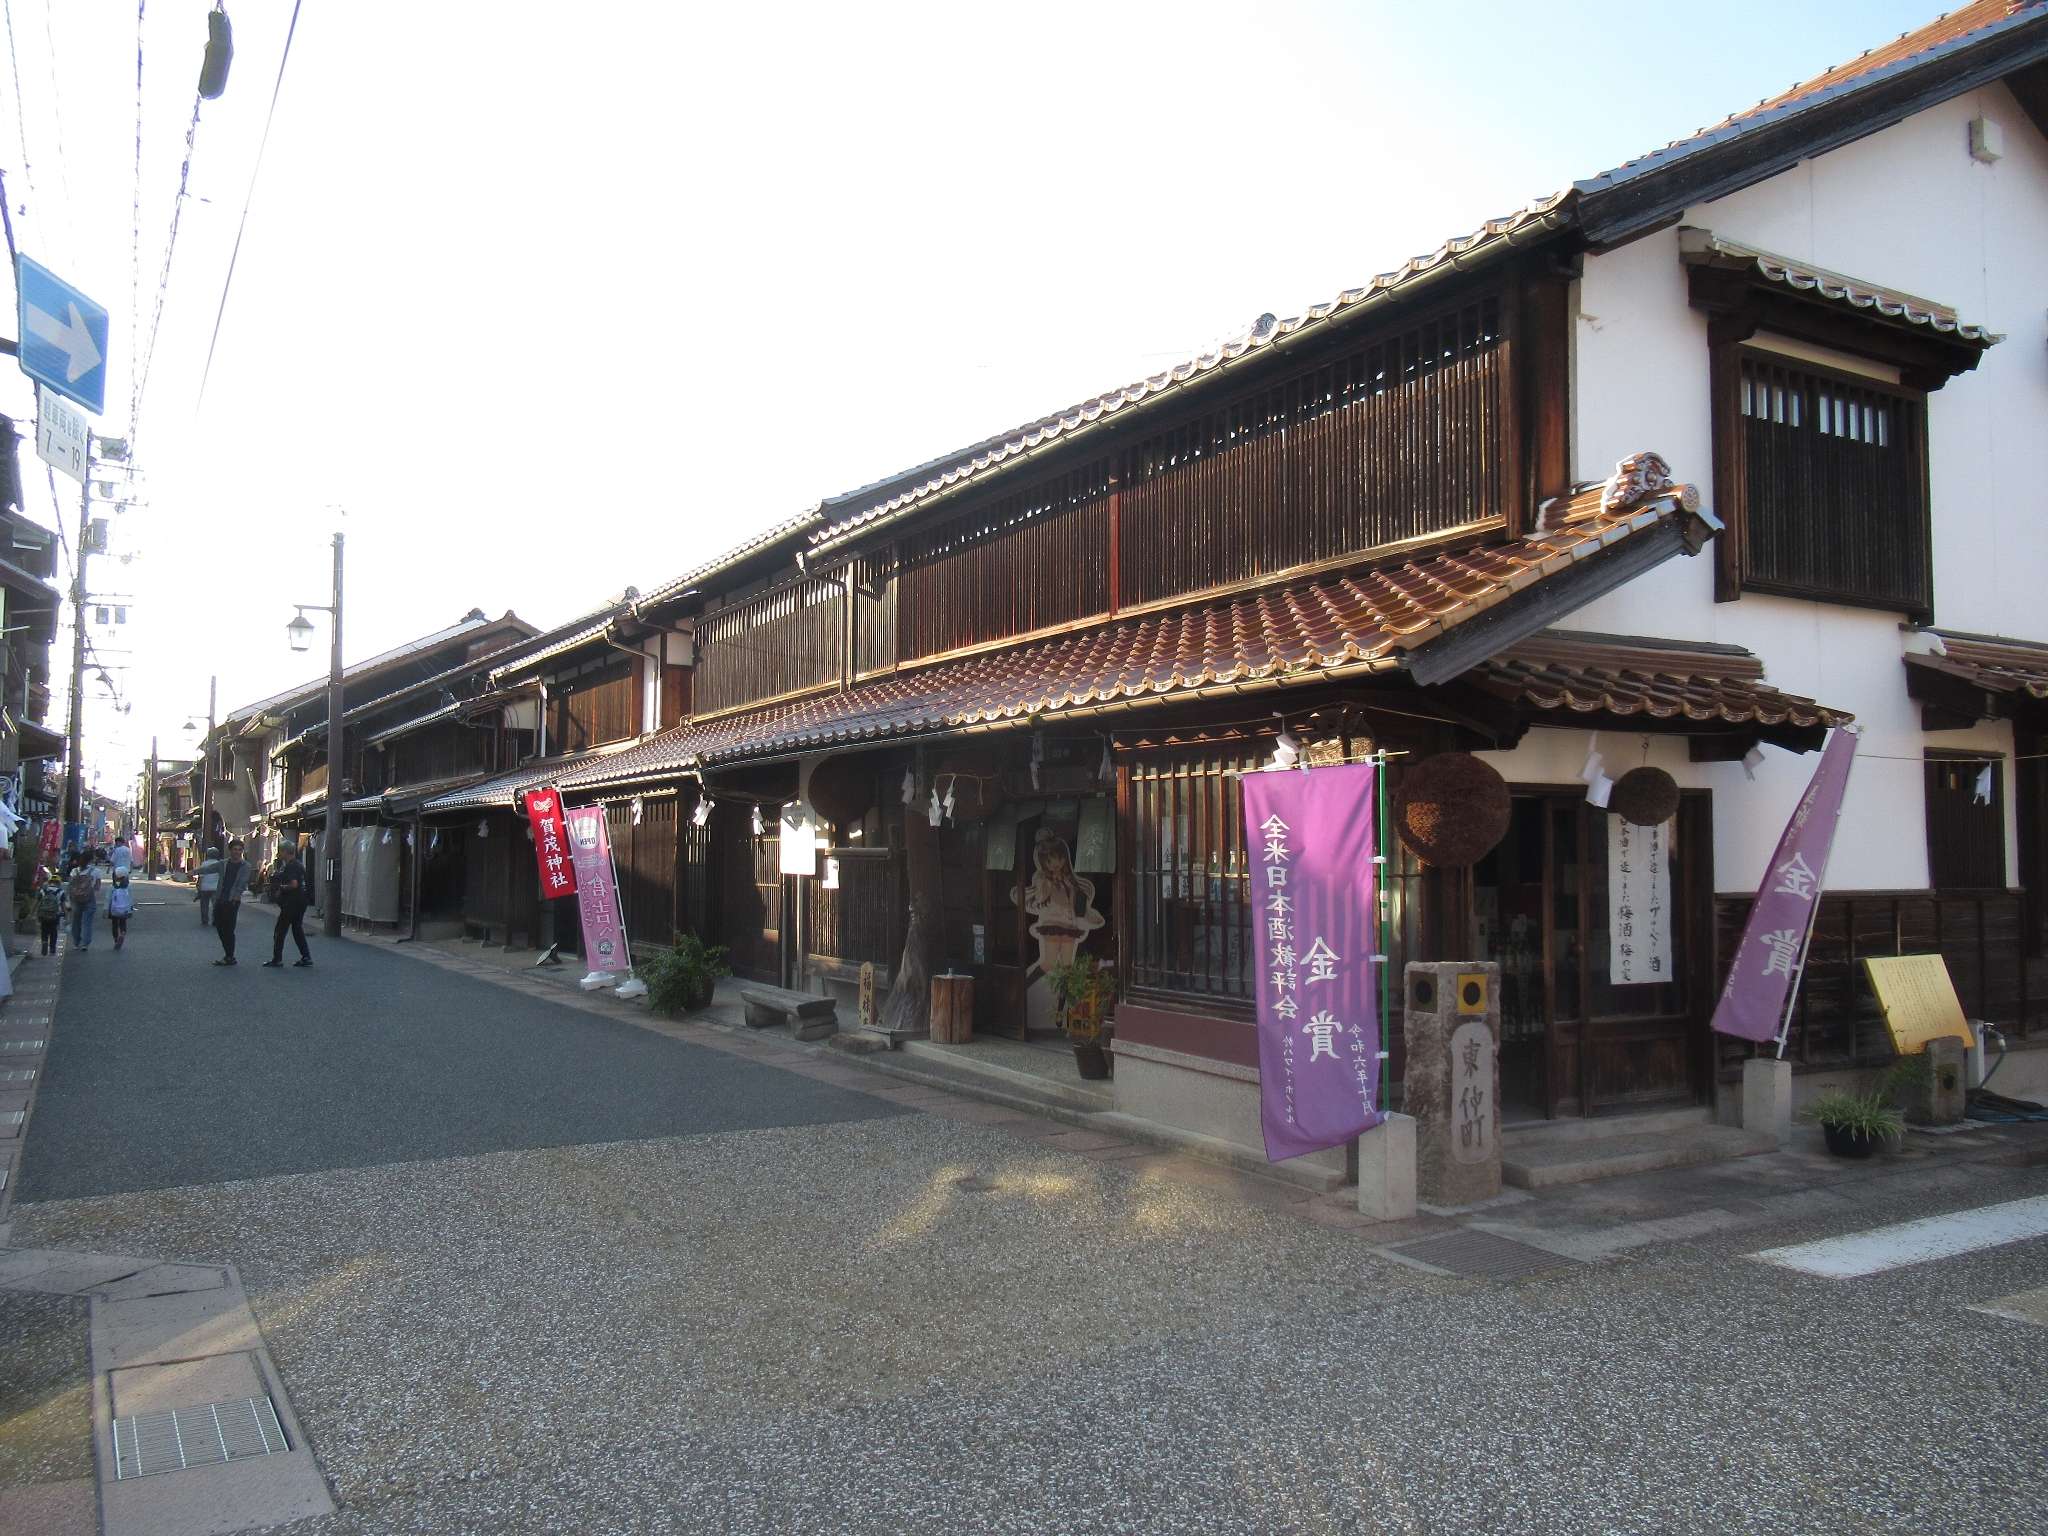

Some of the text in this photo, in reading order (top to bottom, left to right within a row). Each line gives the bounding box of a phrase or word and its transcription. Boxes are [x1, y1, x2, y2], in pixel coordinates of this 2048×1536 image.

[539, 817, 569, 888] 賀茂神社
[1760, 852, 1816, 981] 金賞
[1459, 1038, 1485, 1148] 東仲町
